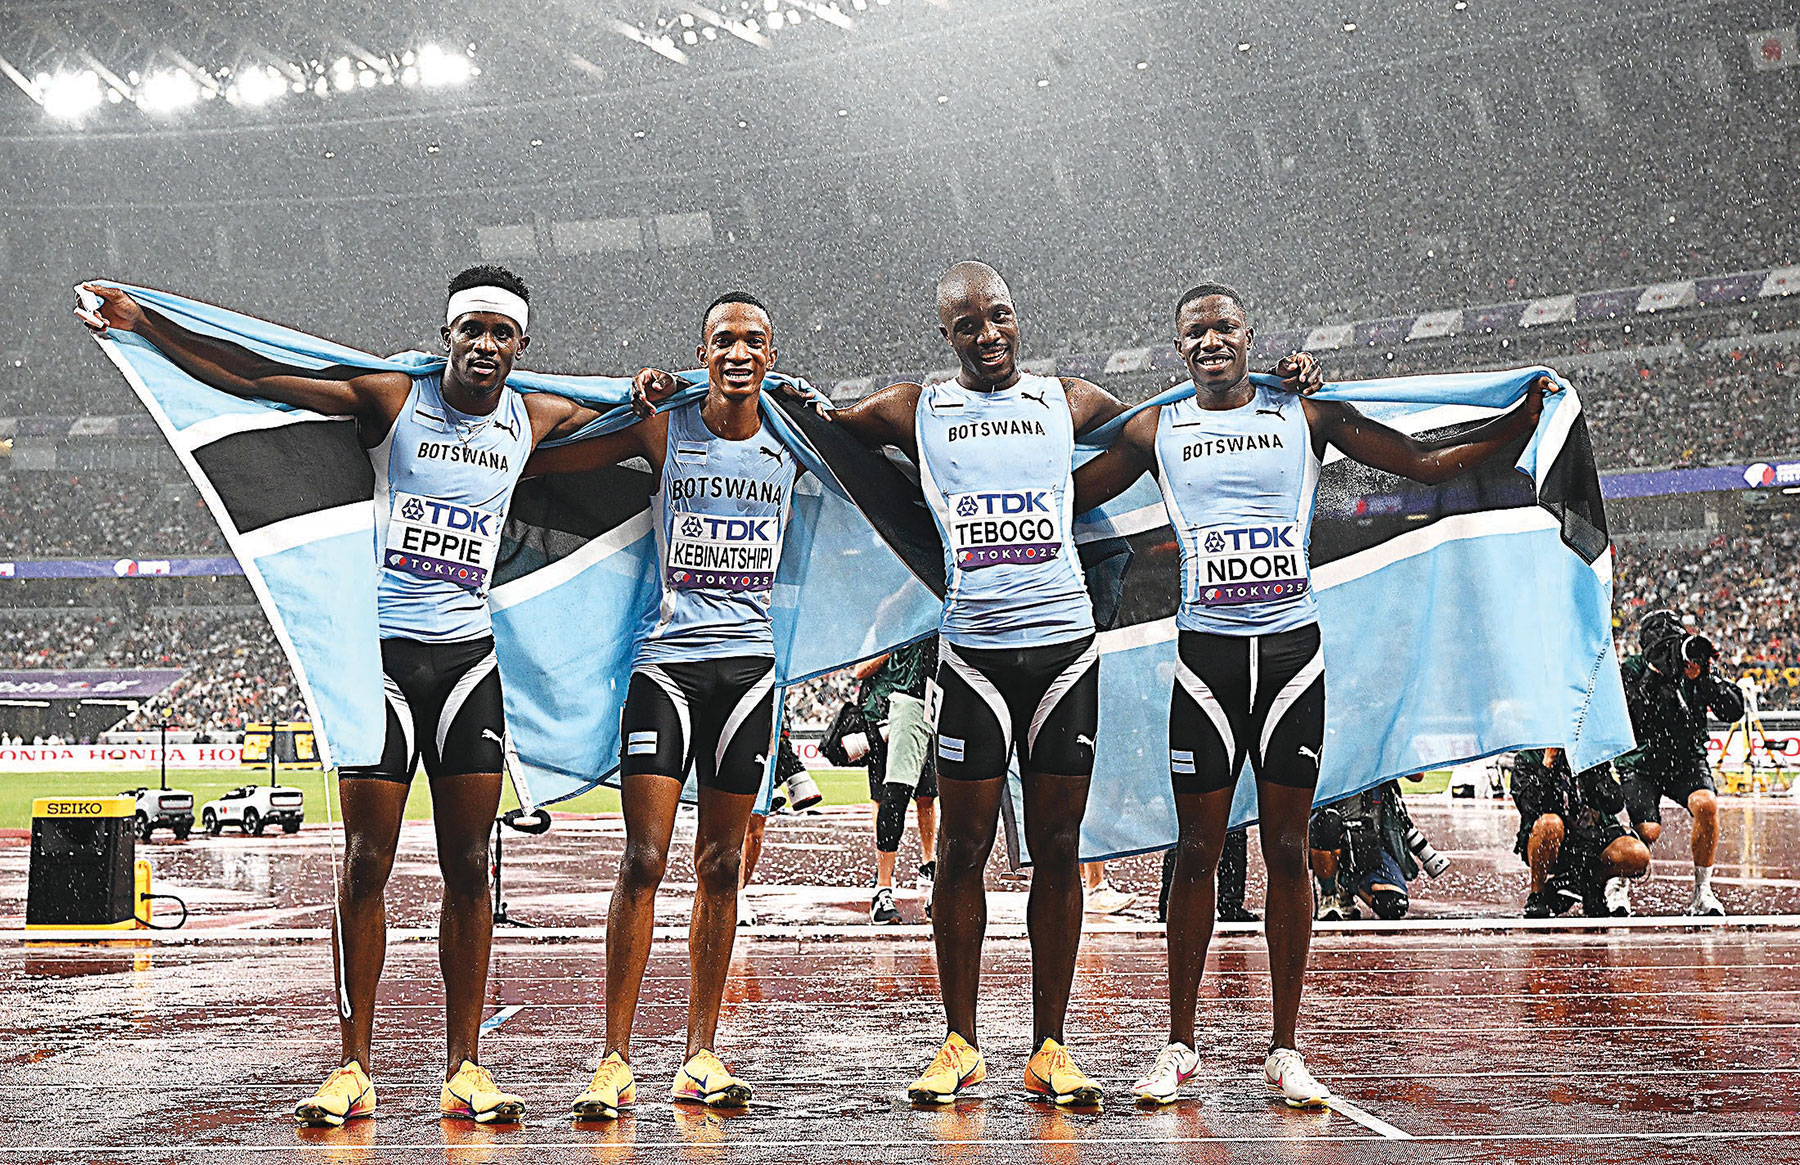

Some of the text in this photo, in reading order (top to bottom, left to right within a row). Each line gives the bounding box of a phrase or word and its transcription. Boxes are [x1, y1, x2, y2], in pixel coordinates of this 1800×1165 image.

[948, 420, 1045, 442] BOTSWANA
[417, 442, 509, 472] BOTSWANA
[1183, 434, 1283, 462] BOTSWANA
[672, 477, 781, 506] BOTSWANA
[977, 491, 1049, 514] TDK
[425, 501, 492, 537] TDK
[703, 518, 770, 541] TDK
[955, 518, 1054, 545] TEBOGO
[402, 526, 483, 564] EPPIE
[1223, 526, 1294, 550] TDK
[674, 542, 773, 569] KEBINATSHIPI
[1207, 554, 1298, 582] NDORI
[90, 749, 186, 761] HONDA
[47, 802, 102, 815] SEIKO
